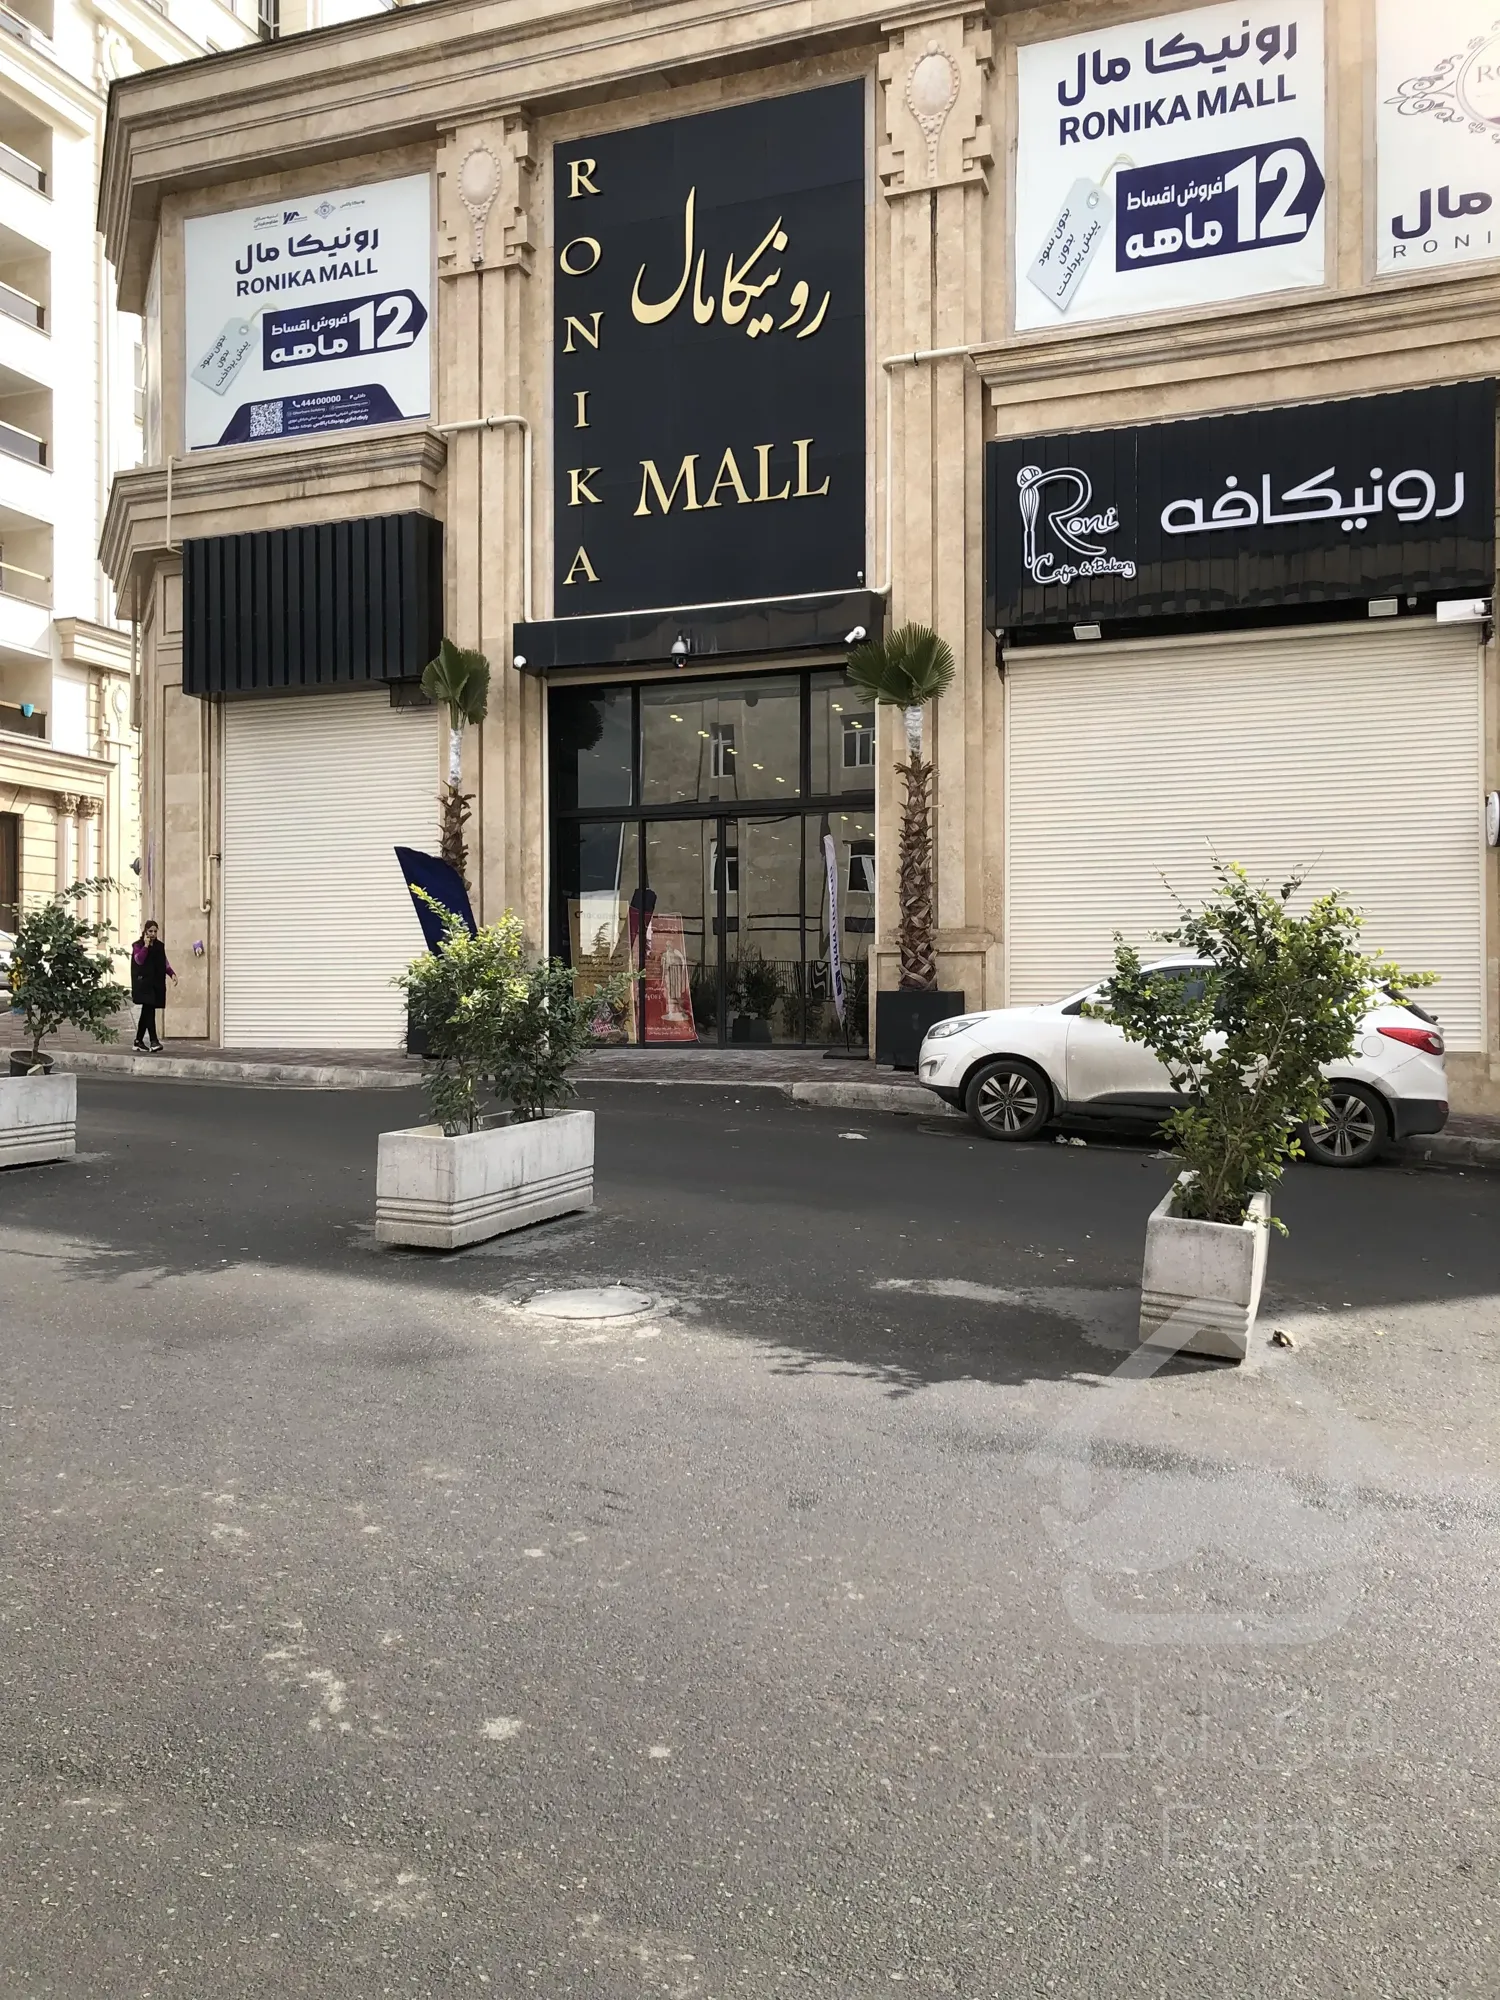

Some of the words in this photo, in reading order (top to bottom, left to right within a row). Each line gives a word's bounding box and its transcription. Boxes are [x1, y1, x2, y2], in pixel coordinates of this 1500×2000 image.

[1145, 19, 1298, 74] رونیکا
[1057, 48, 1131, 107] مال
[1059, 94, 1192, 146] RONIKA
[1197, 73, 1297, 119] MALL
[1126, 184, 1175, 211] اقساط
[1177, 175, 1223, 208] فروش
[1224, 147, 1307, 243] 12
[1055, 207, 1072, 240] بدون
[1391, 184, 1493, 240] مال
[288, 226, 379, 258] رونیکا
[1058, 233, 1076, 265] بدون
[1082, 219, 1102, 254] پیش
[1125, 211, 1223, 259] ماهه
[235, 243, 280, 275] مال
[1038, 237, 1056, 267] سود
[236, 268, 316, 297] RONIKA
[319, 257, 379, 283] MALL
[1056, 251, 1084, 297] پرداخت
[271, 319, 310, 336] اقساط
[311, 313, 349, 332] فروش
[348, 295, 414, 351] 12
[200, 352, 215, 369] سود
[214, 335, 227, 354] بدون
[216, 349, 231, 369] بدون
[270, 333, 349, 363] ماهه
[301, 394, 342, 407] 44400000
[632, 437, 832, 518] MALL
[1022, 466, 1120, 556] Roni
[1032, 553, 1078, 584] Cafe
[1079, 561, 1094, 576] &
[1092, 556, 1137, 579] Bakery
